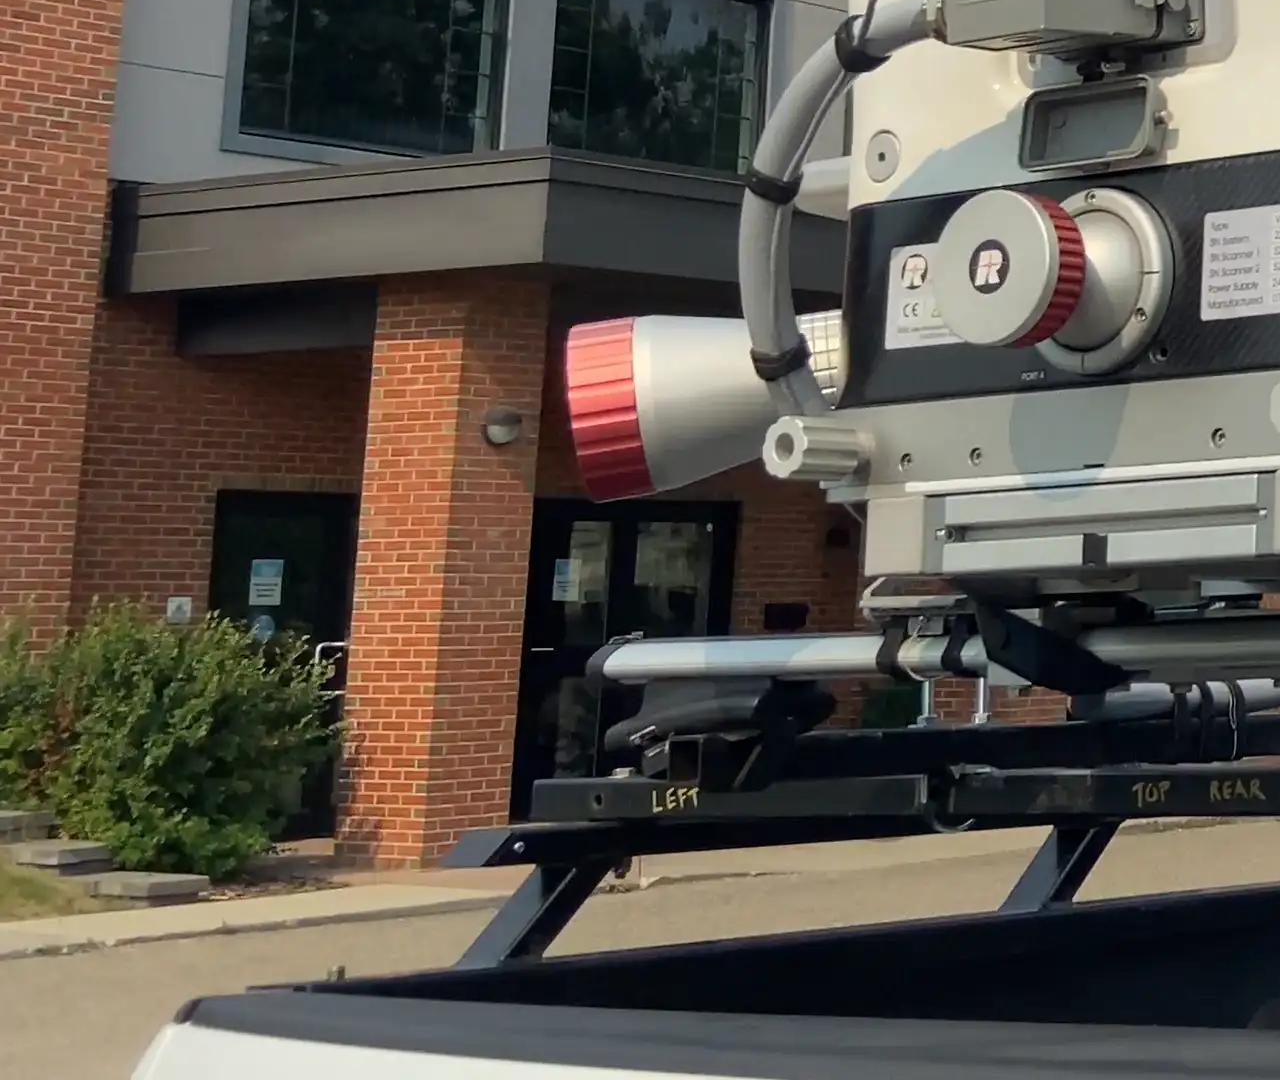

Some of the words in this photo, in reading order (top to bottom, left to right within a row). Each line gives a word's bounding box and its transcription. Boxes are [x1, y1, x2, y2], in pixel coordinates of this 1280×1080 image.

[652, 787, 700, 814] LEFT
[1132, 781, 1171, 809] TOP
[1209, 778, 1266, 802] REAR
